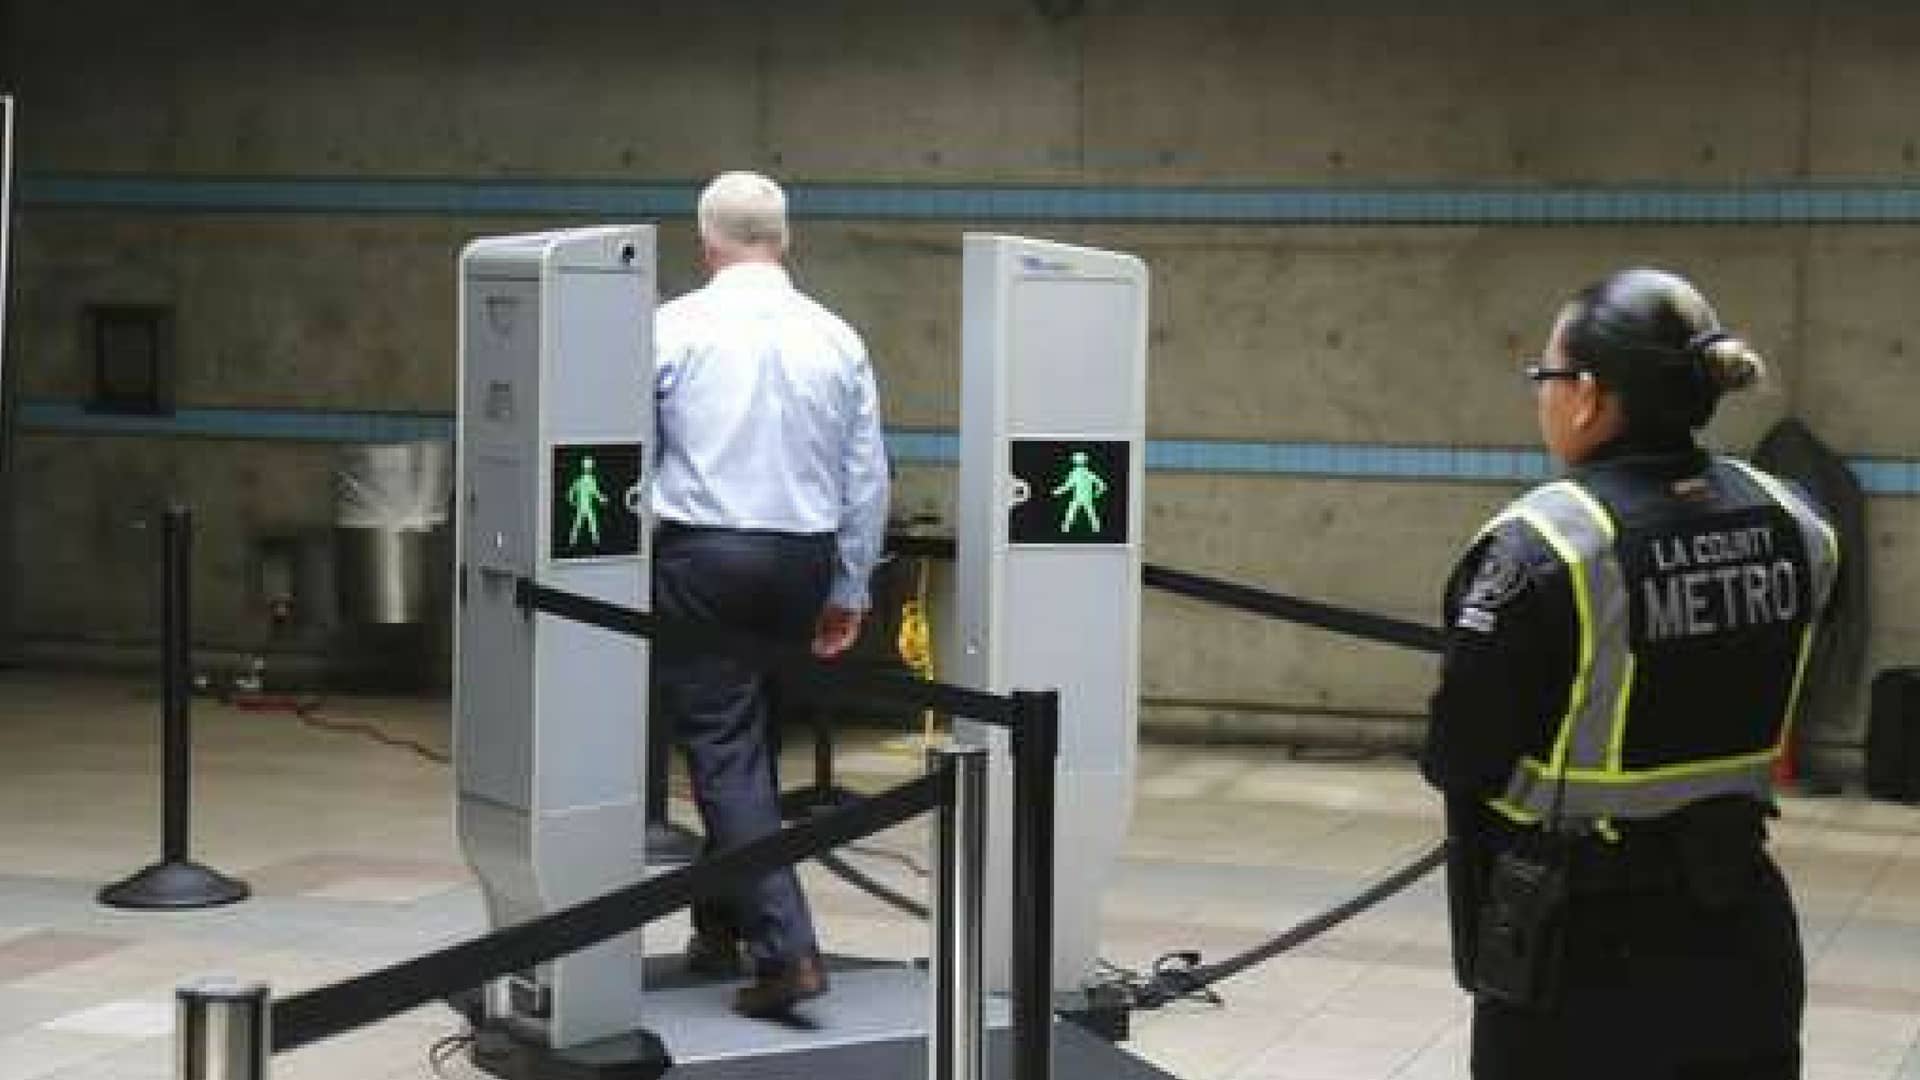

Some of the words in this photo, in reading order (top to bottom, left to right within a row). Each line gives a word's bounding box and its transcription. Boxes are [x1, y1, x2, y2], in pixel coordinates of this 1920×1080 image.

[1652, 538, 1690, 571] LA
[1693, 528, 1774, 564] COUNTY
[1643, 561, 1797, 641] METRO
